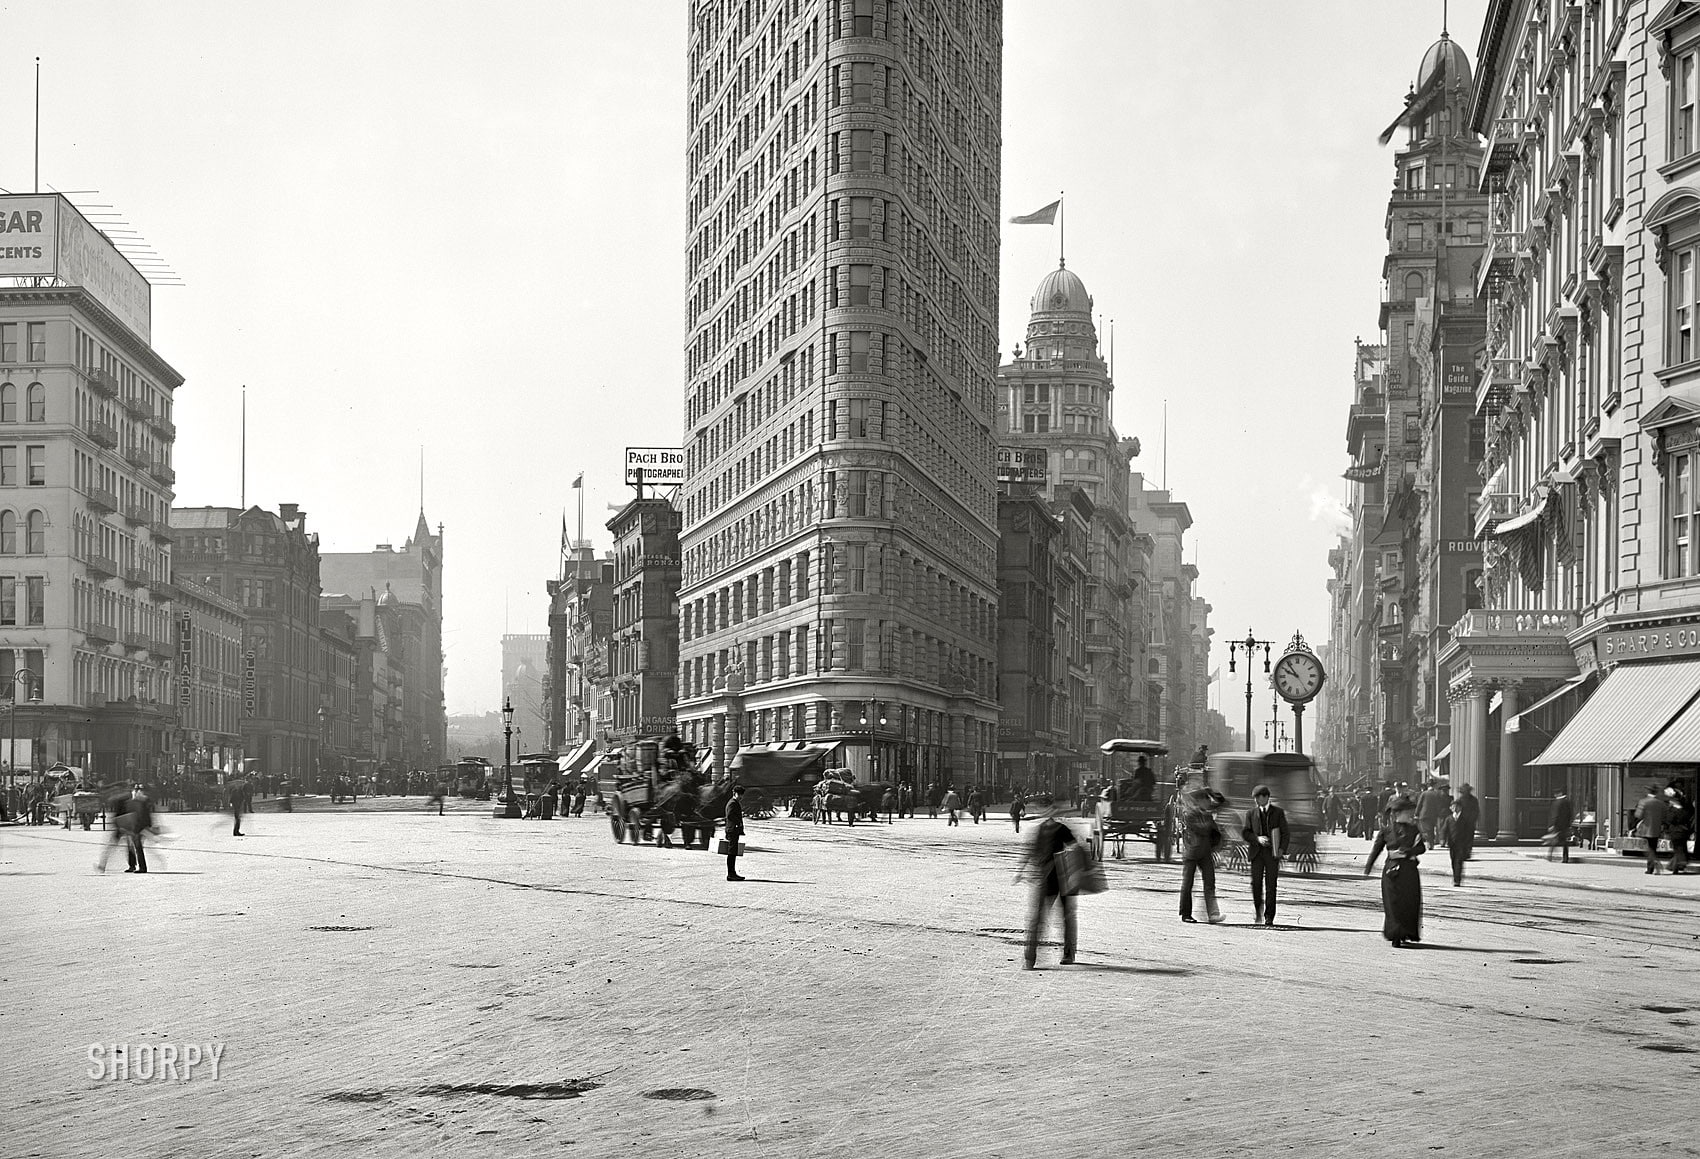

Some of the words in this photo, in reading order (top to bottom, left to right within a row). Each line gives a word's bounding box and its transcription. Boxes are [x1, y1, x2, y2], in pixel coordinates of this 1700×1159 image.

[1452, 365, 1465, 373] The
[1448, 375, 1469, 383] Guide
[629, 452, 657, 464] PACH
[661, 452, 683, 464] BRO
[628, 468, 684, 478] PHTOGRAPHE
[1606, 634, 1659, 655] SHARP
[1664, 632, 1674, 649] &
[181, 608, 191, 706] BILLIARDS
[245, 650, 255, 718] SLOSSON
